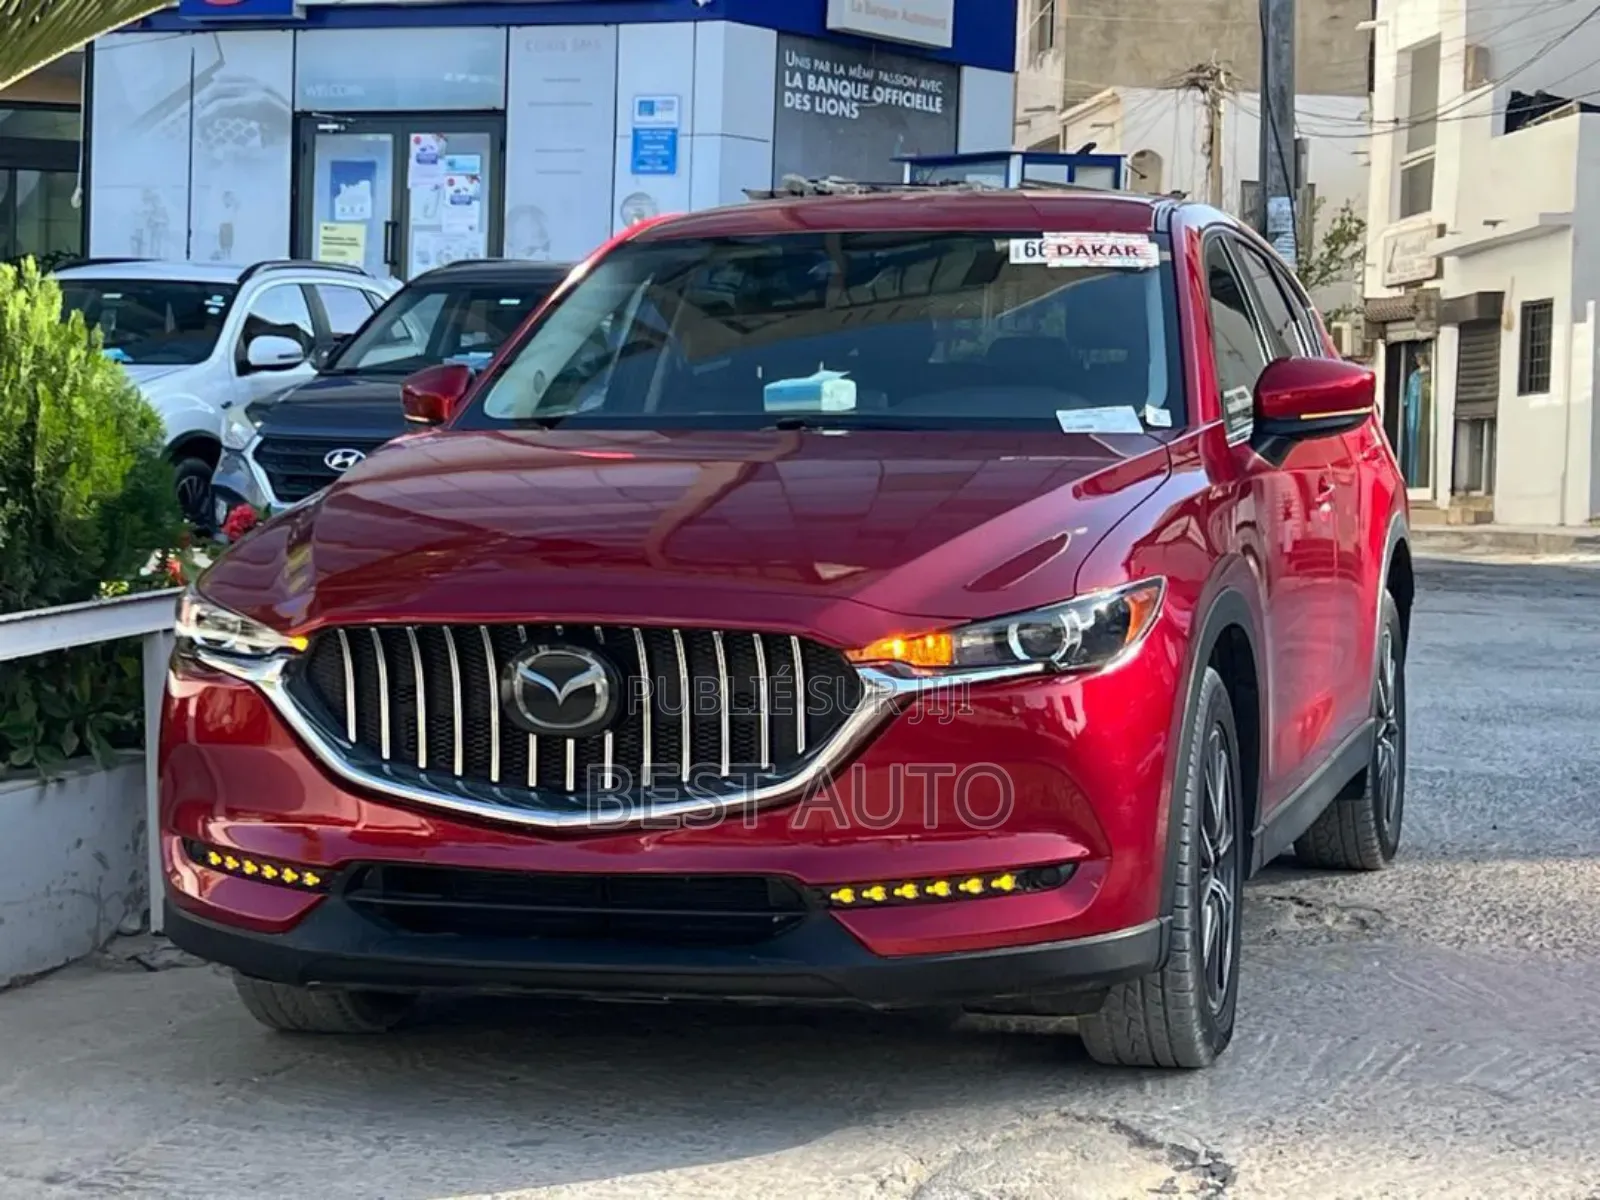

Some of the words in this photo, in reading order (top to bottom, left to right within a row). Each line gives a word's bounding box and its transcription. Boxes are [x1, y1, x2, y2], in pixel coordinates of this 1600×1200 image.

[785, 70, 803, 90] LA
[807, 74, 870, 102] BANQUE
[872, 85, 944, 114] OFFICIELLE
[814, 59, 831, 74] PAR
[833, 62, 845, 77] LA
[878, 70, 917, 90] PASSION
[919, 79, 943, 94] AVEC
[784, 91, 811, 112] DES
[815, 96, 860, 120] LIONS
[1057, 244, 1139, 258] DAKAR
